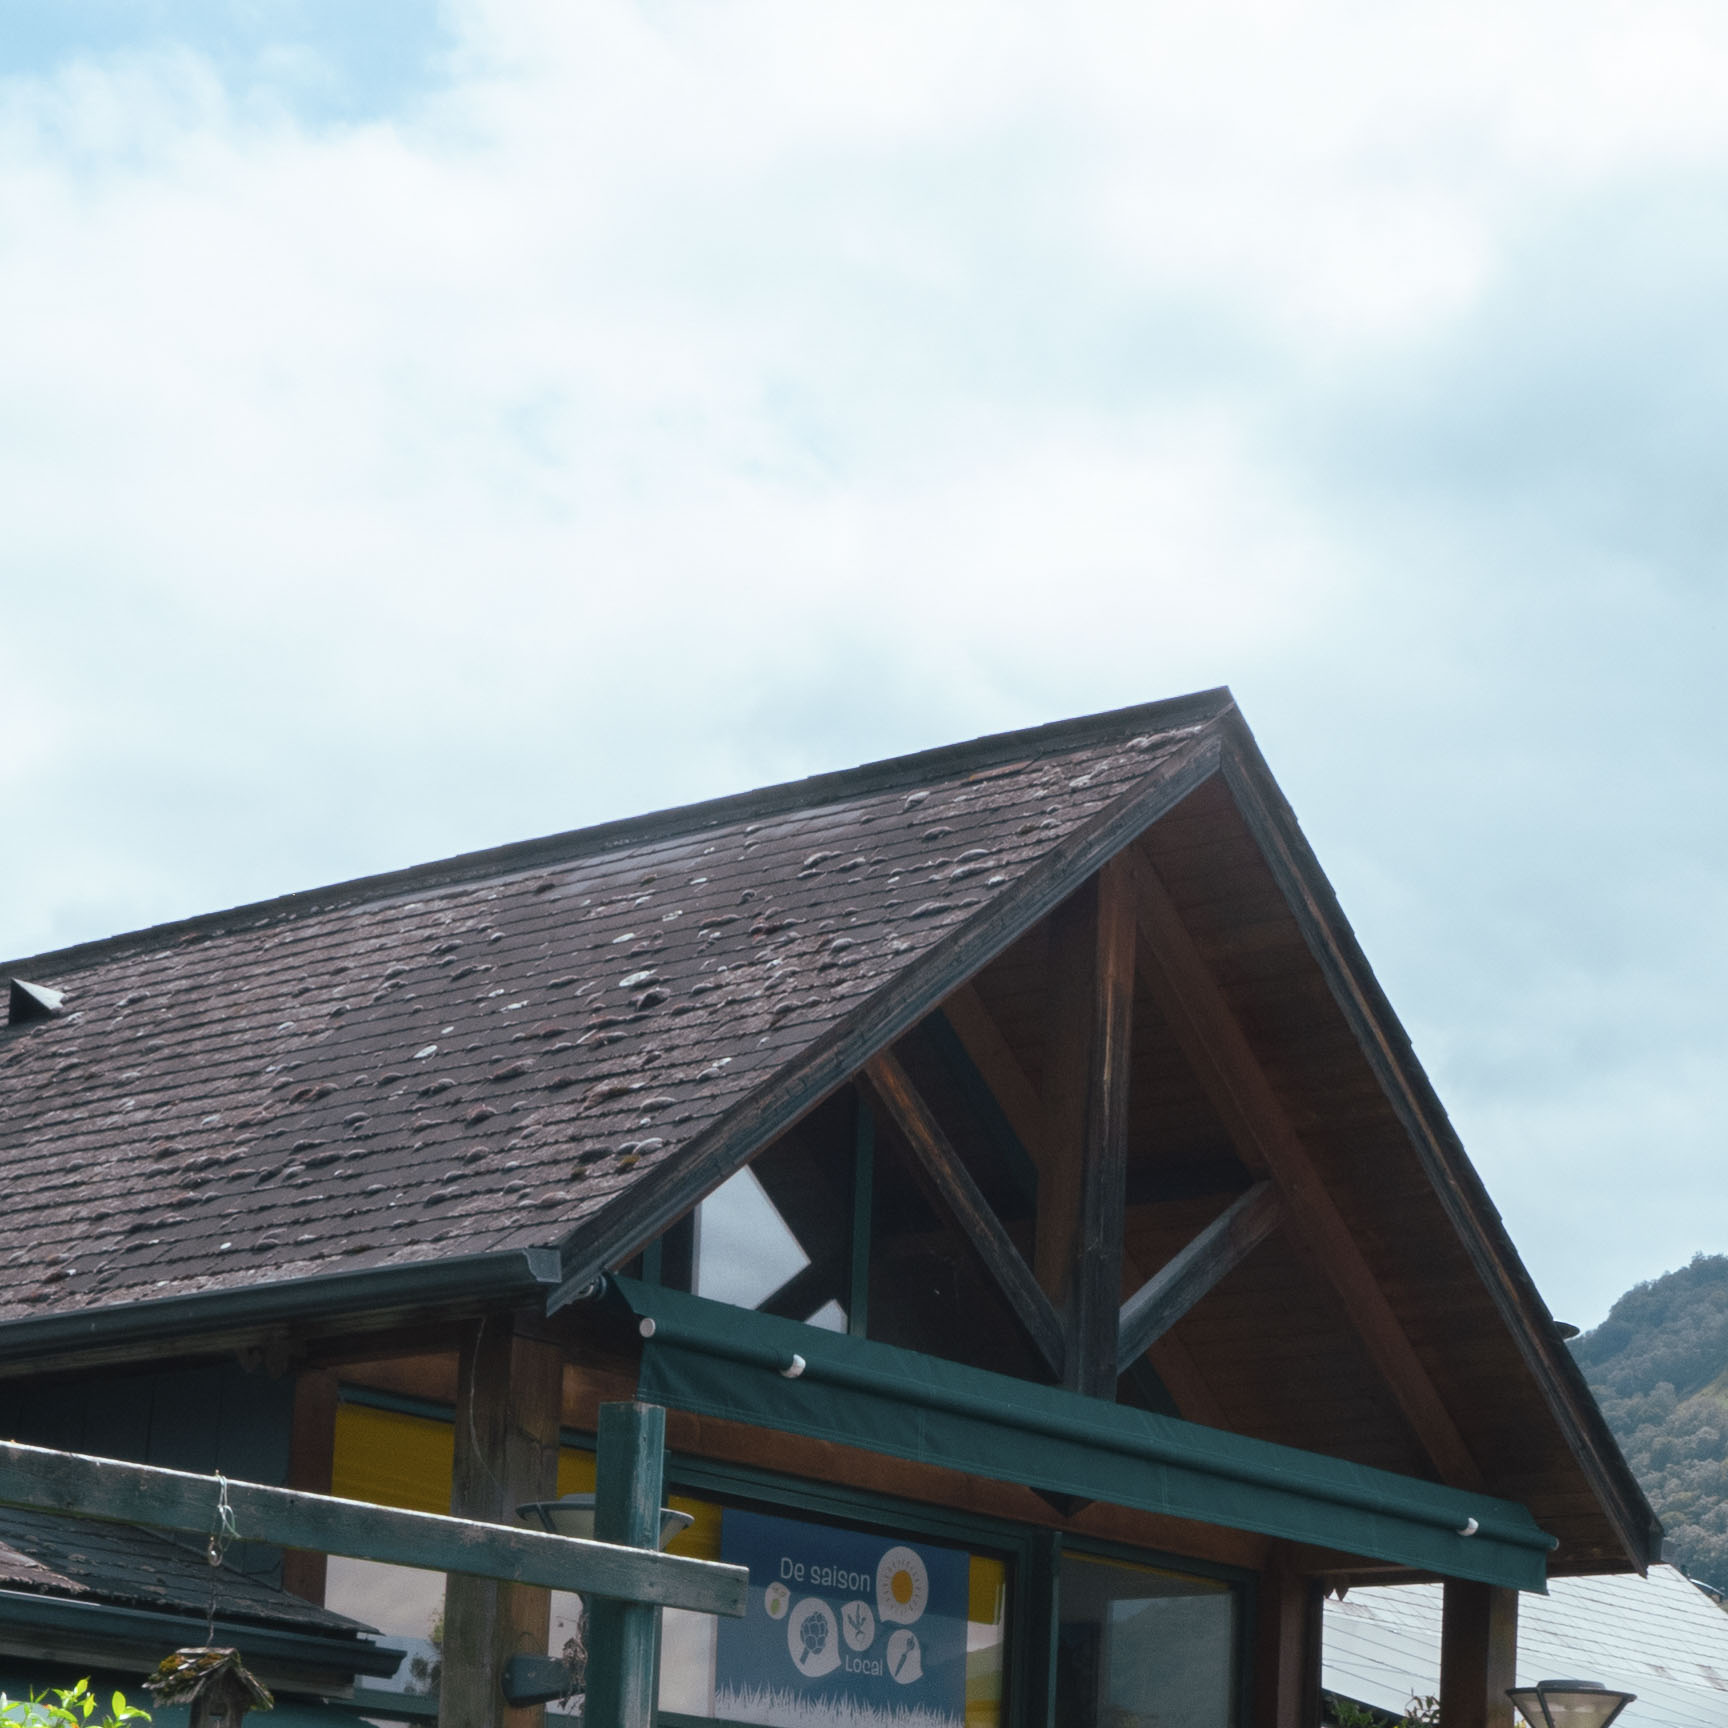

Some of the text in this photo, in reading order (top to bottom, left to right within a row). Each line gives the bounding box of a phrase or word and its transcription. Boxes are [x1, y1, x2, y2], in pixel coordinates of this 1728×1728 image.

[779, 1556, 871, 1593] De saison
[844, 1654, 884, 1677] Local
